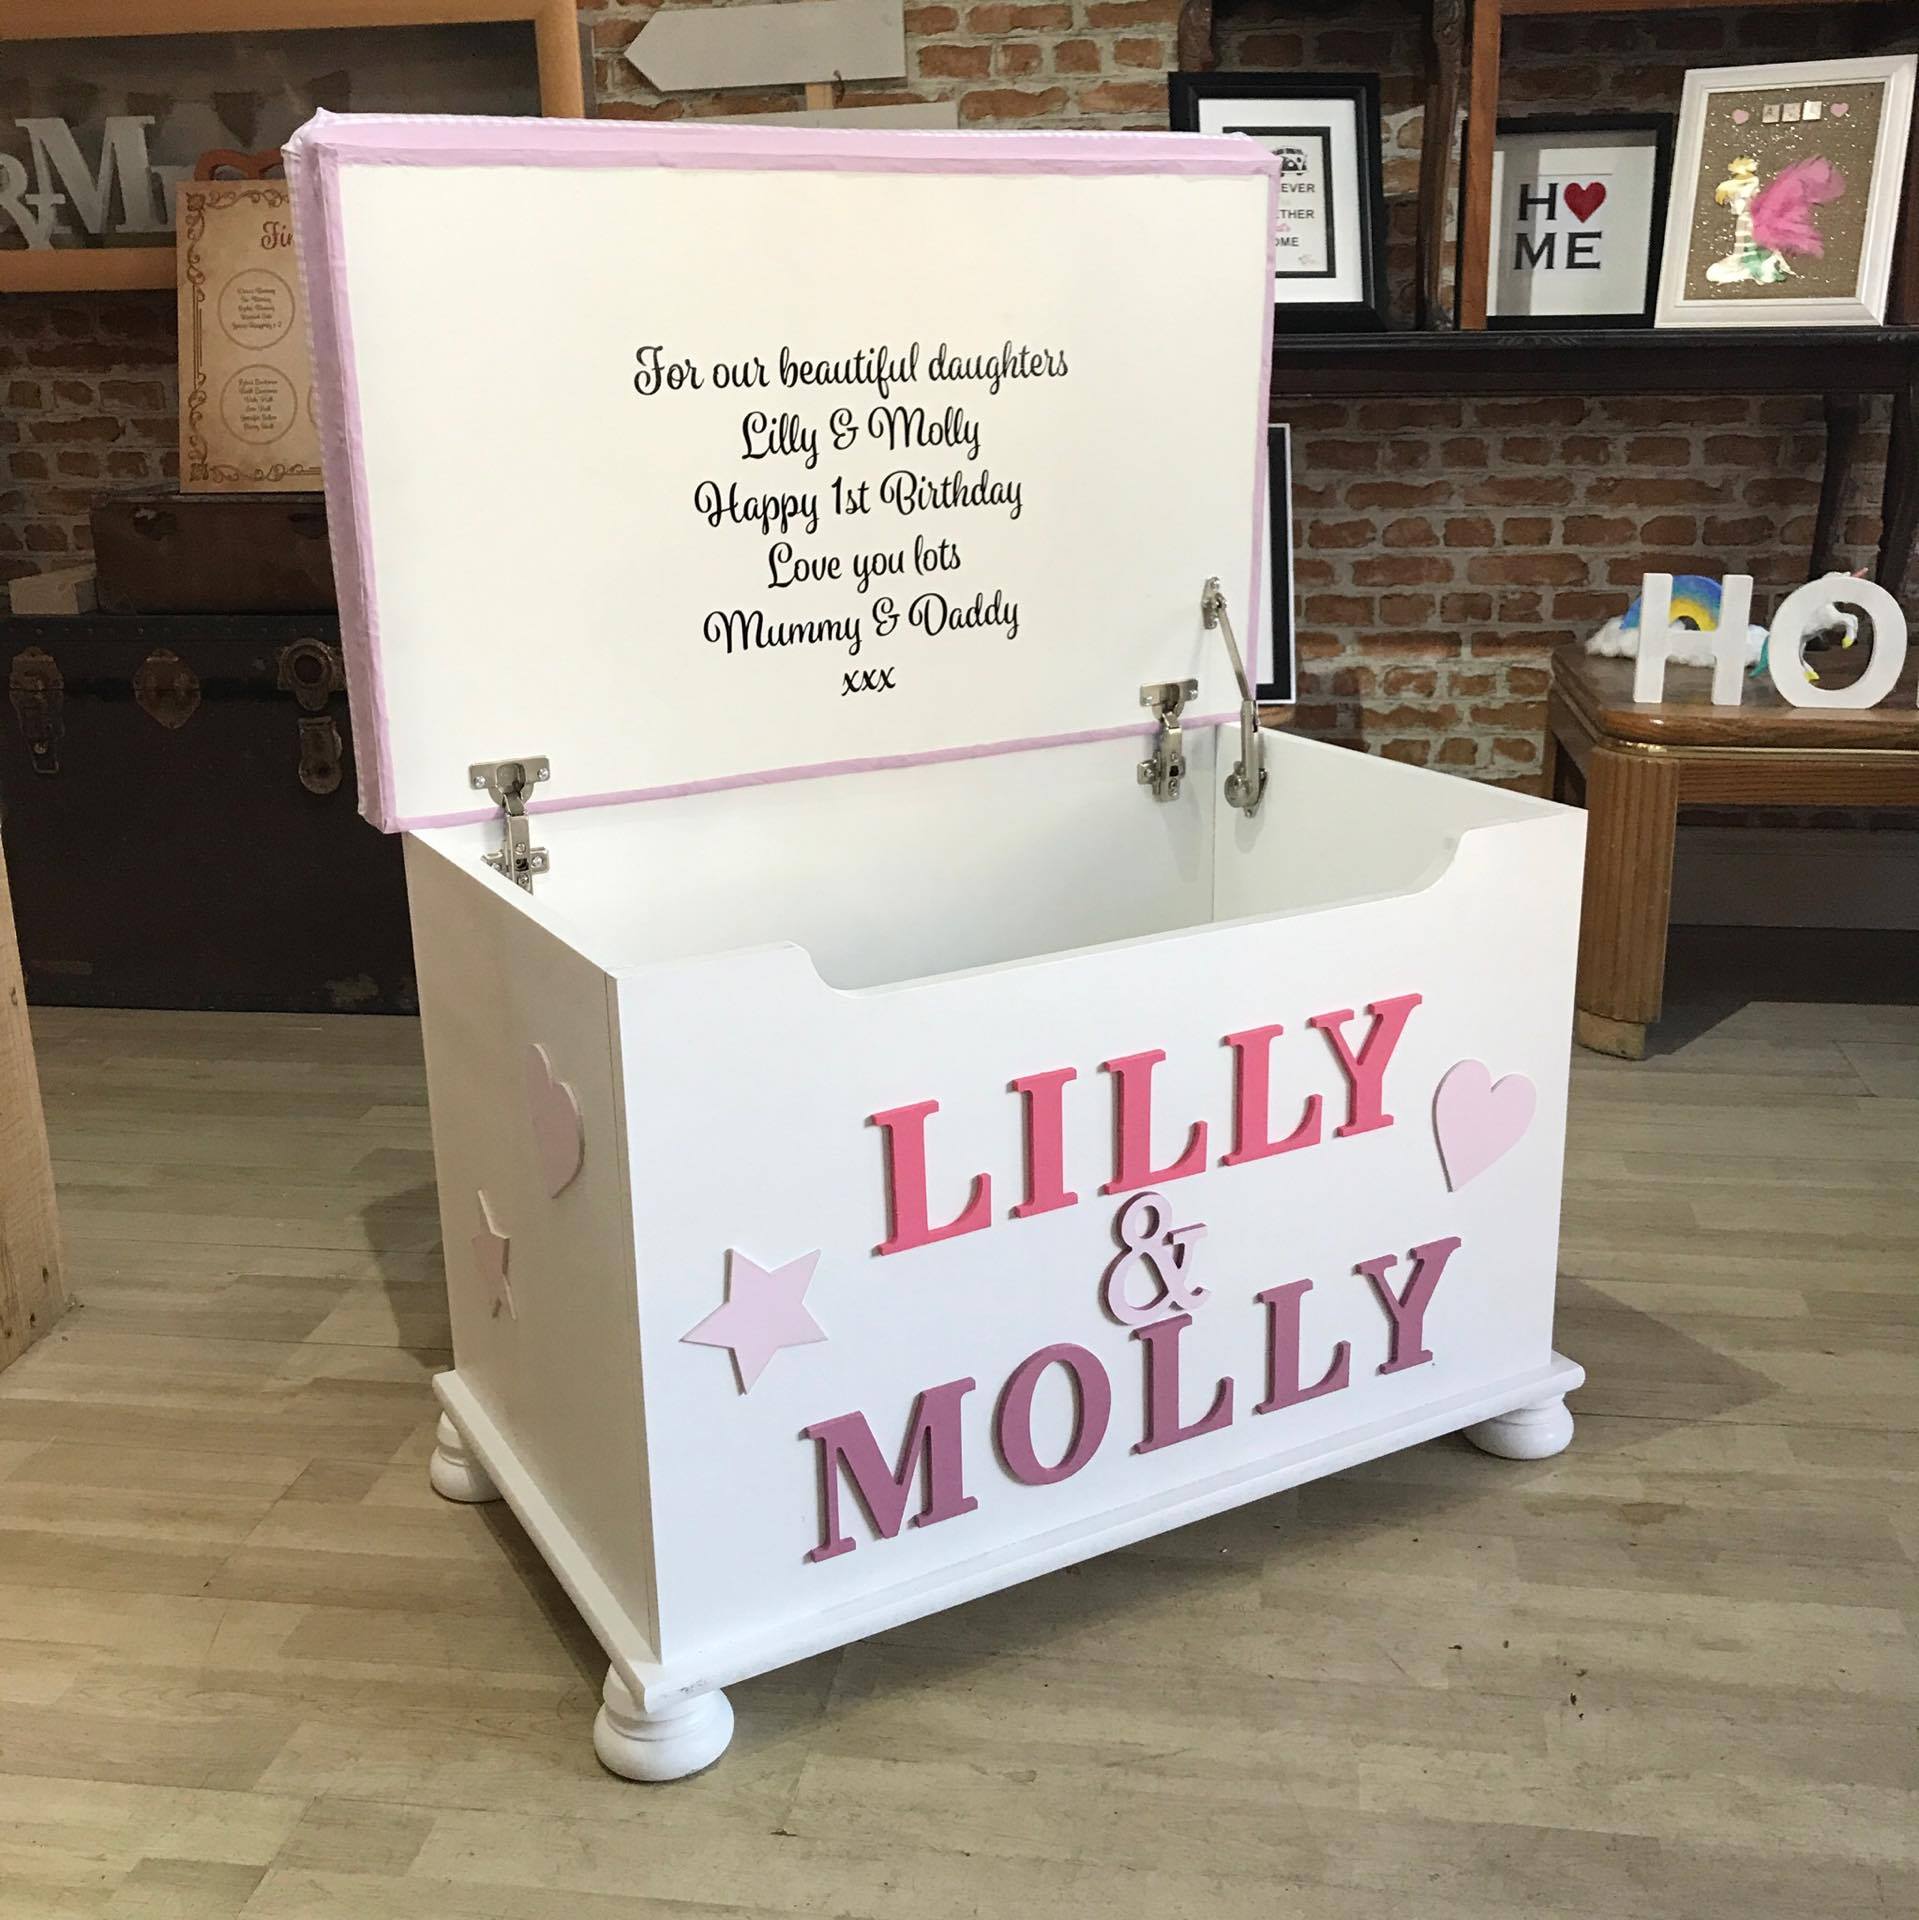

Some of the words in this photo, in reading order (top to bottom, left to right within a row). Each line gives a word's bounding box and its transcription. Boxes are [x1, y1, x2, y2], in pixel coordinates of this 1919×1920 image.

[1276, 209, 1315, 219] THER
[633, 345, 703, 396] For
[712, 357, 770, 390] our
[779, 341, 919, 400] beautiful
[928, 340, 1069, 396] daughters
[741, 411, 819, 470] Lilly
[829, 407, 859, 451] &
[867, 406, 981, 461] Molly
[694, 480, 819, 536] Happy
[831, 475, 871, 515] 1st
[879, 469, 1023, 520] Birthday
[767, 541, 842, 589] Love
[853, 550, 905, 594] you
[914, 534, 961, 576] lots
[703, 609, 863, 656] Mummy
[872, 596, 901, 637] &
[908, 589, 1019, 640] Daddy
[1633, 572, 1919, 709] HO
[841, 666, 896, 696] xxx
[867, 992, 1423, 1257] LILLY
[1102, 1190, 1212, 1326] &
[800, 1235, 1462, 1564] MOLLY
